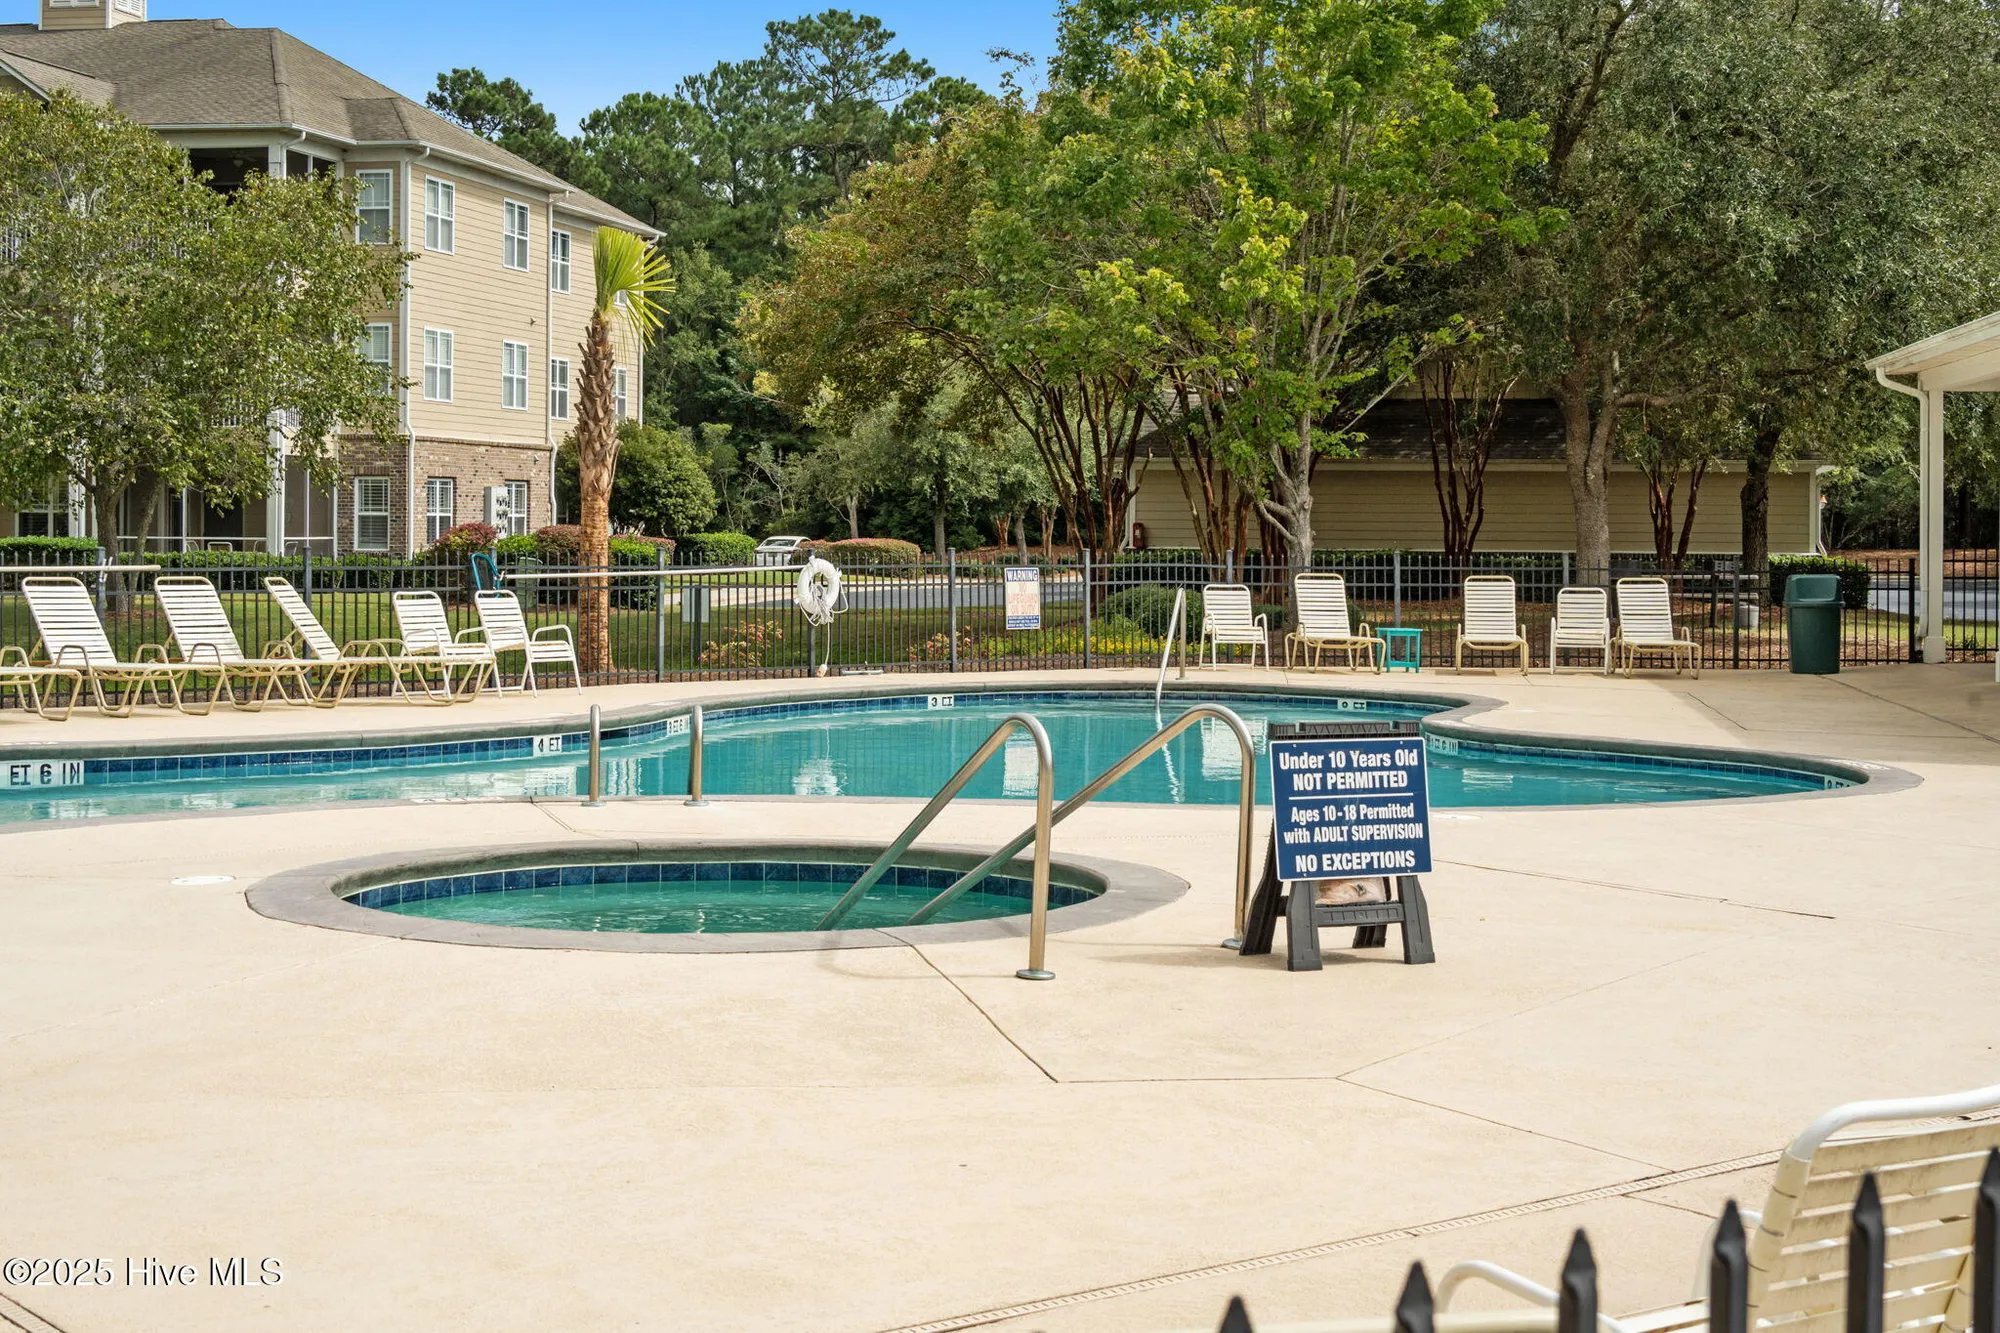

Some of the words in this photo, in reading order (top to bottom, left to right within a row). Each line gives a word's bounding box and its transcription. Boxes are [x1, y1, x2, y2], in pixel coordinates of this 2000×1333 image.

[1007, 570, 1038, 582] WARNING
[1279, 752, 1324, 770] Under
[1328, 751, 1346, 769] 10
[1350, 750, 1392, 768] Years
[1395, 749, 1418, 766] Old
[1292, 772, 1323, 791] NOT
[1326, 771, 1408, 790] PERMITTED
[1291, 807, 1320, 825] Ages
[1360, 803, 1414, 820] Permitted
[1284, 827, 1310, 844] with
[1313, 826, 1348, 842] ADULT
[1351, 823, 1424, 841] SUPERVISION
[1295, 854, 1318, 872] NO
[1322, 850, 1415, 871] EXCEPTIONS
